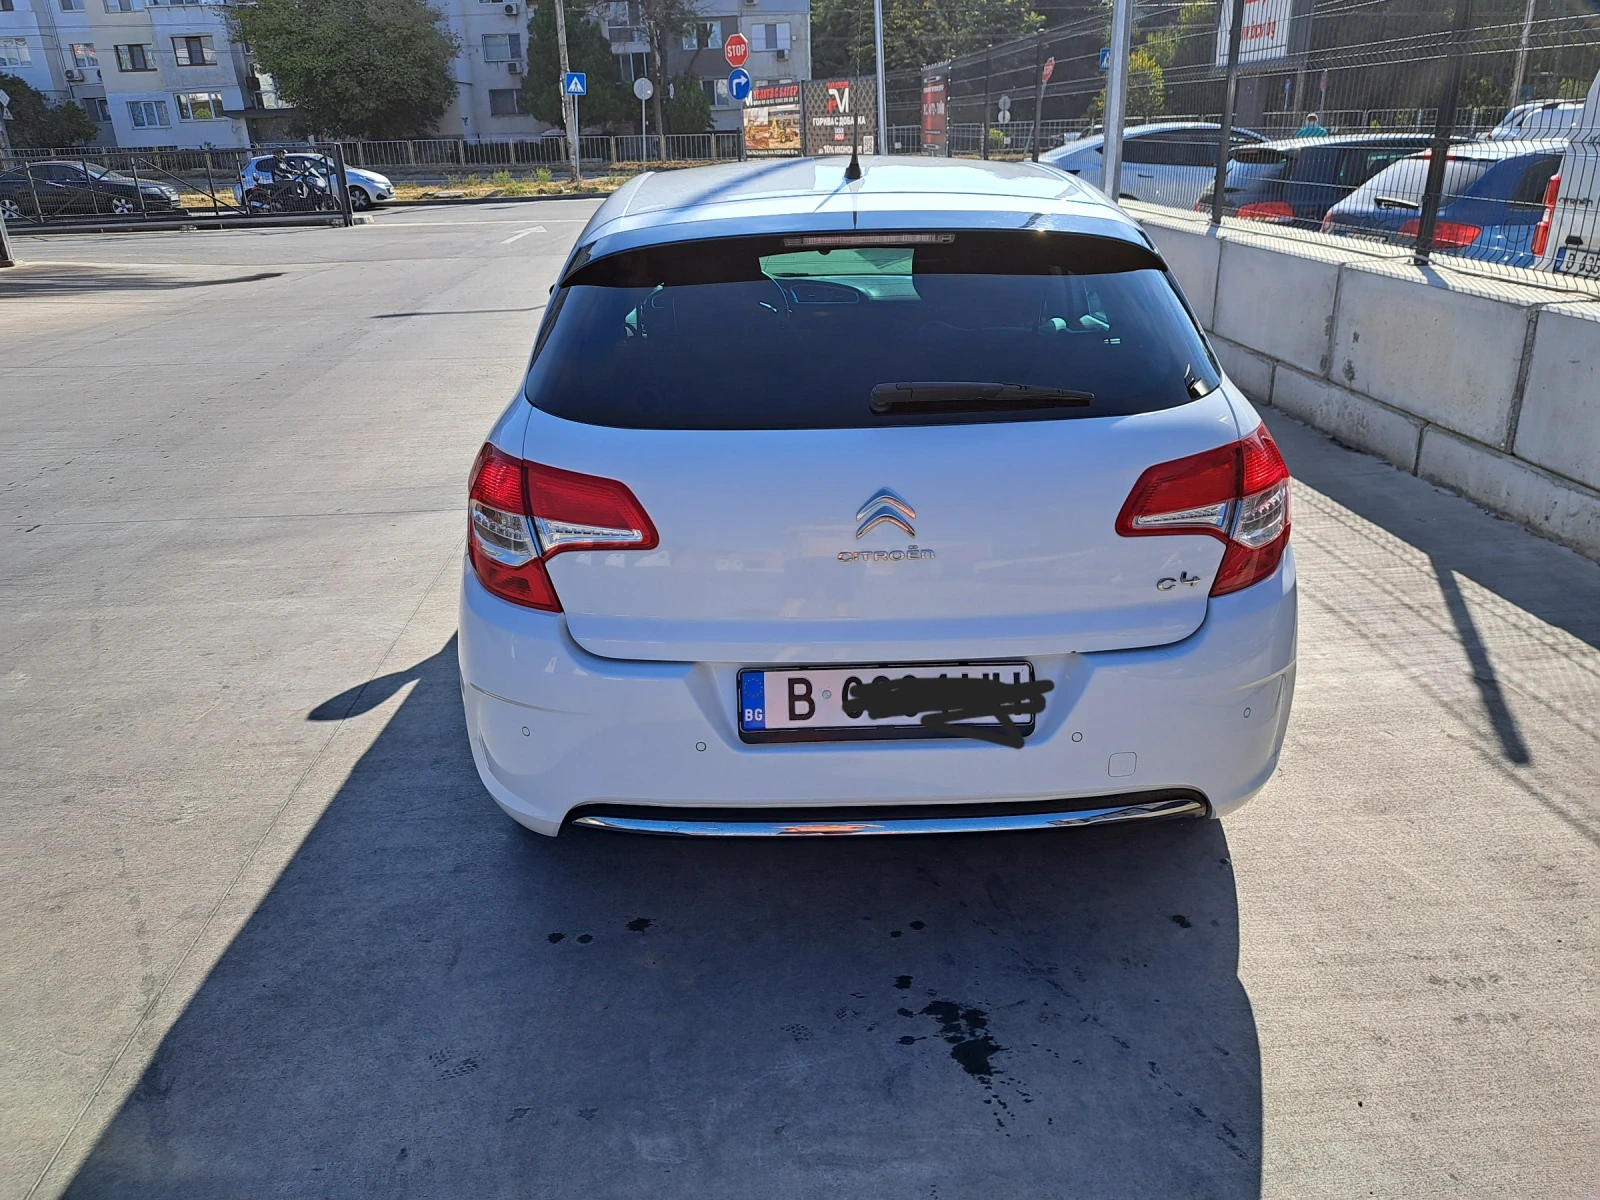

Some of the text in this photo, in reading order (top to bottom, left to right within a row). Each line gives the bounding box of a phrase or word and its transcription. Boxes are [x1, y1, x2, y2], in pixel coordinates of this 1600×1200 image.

[727, 44, 746, 57] STOP
[780, 85, 798, 97] БАГЕР
[812, 117, 834, 126] ГОРИВА
[839, 115, 866, 126] ДОБАКА
[1156, 571, 1201, 591] C4
[787, 677, 815, 721] B
[745, 708, 763, 722] BG
